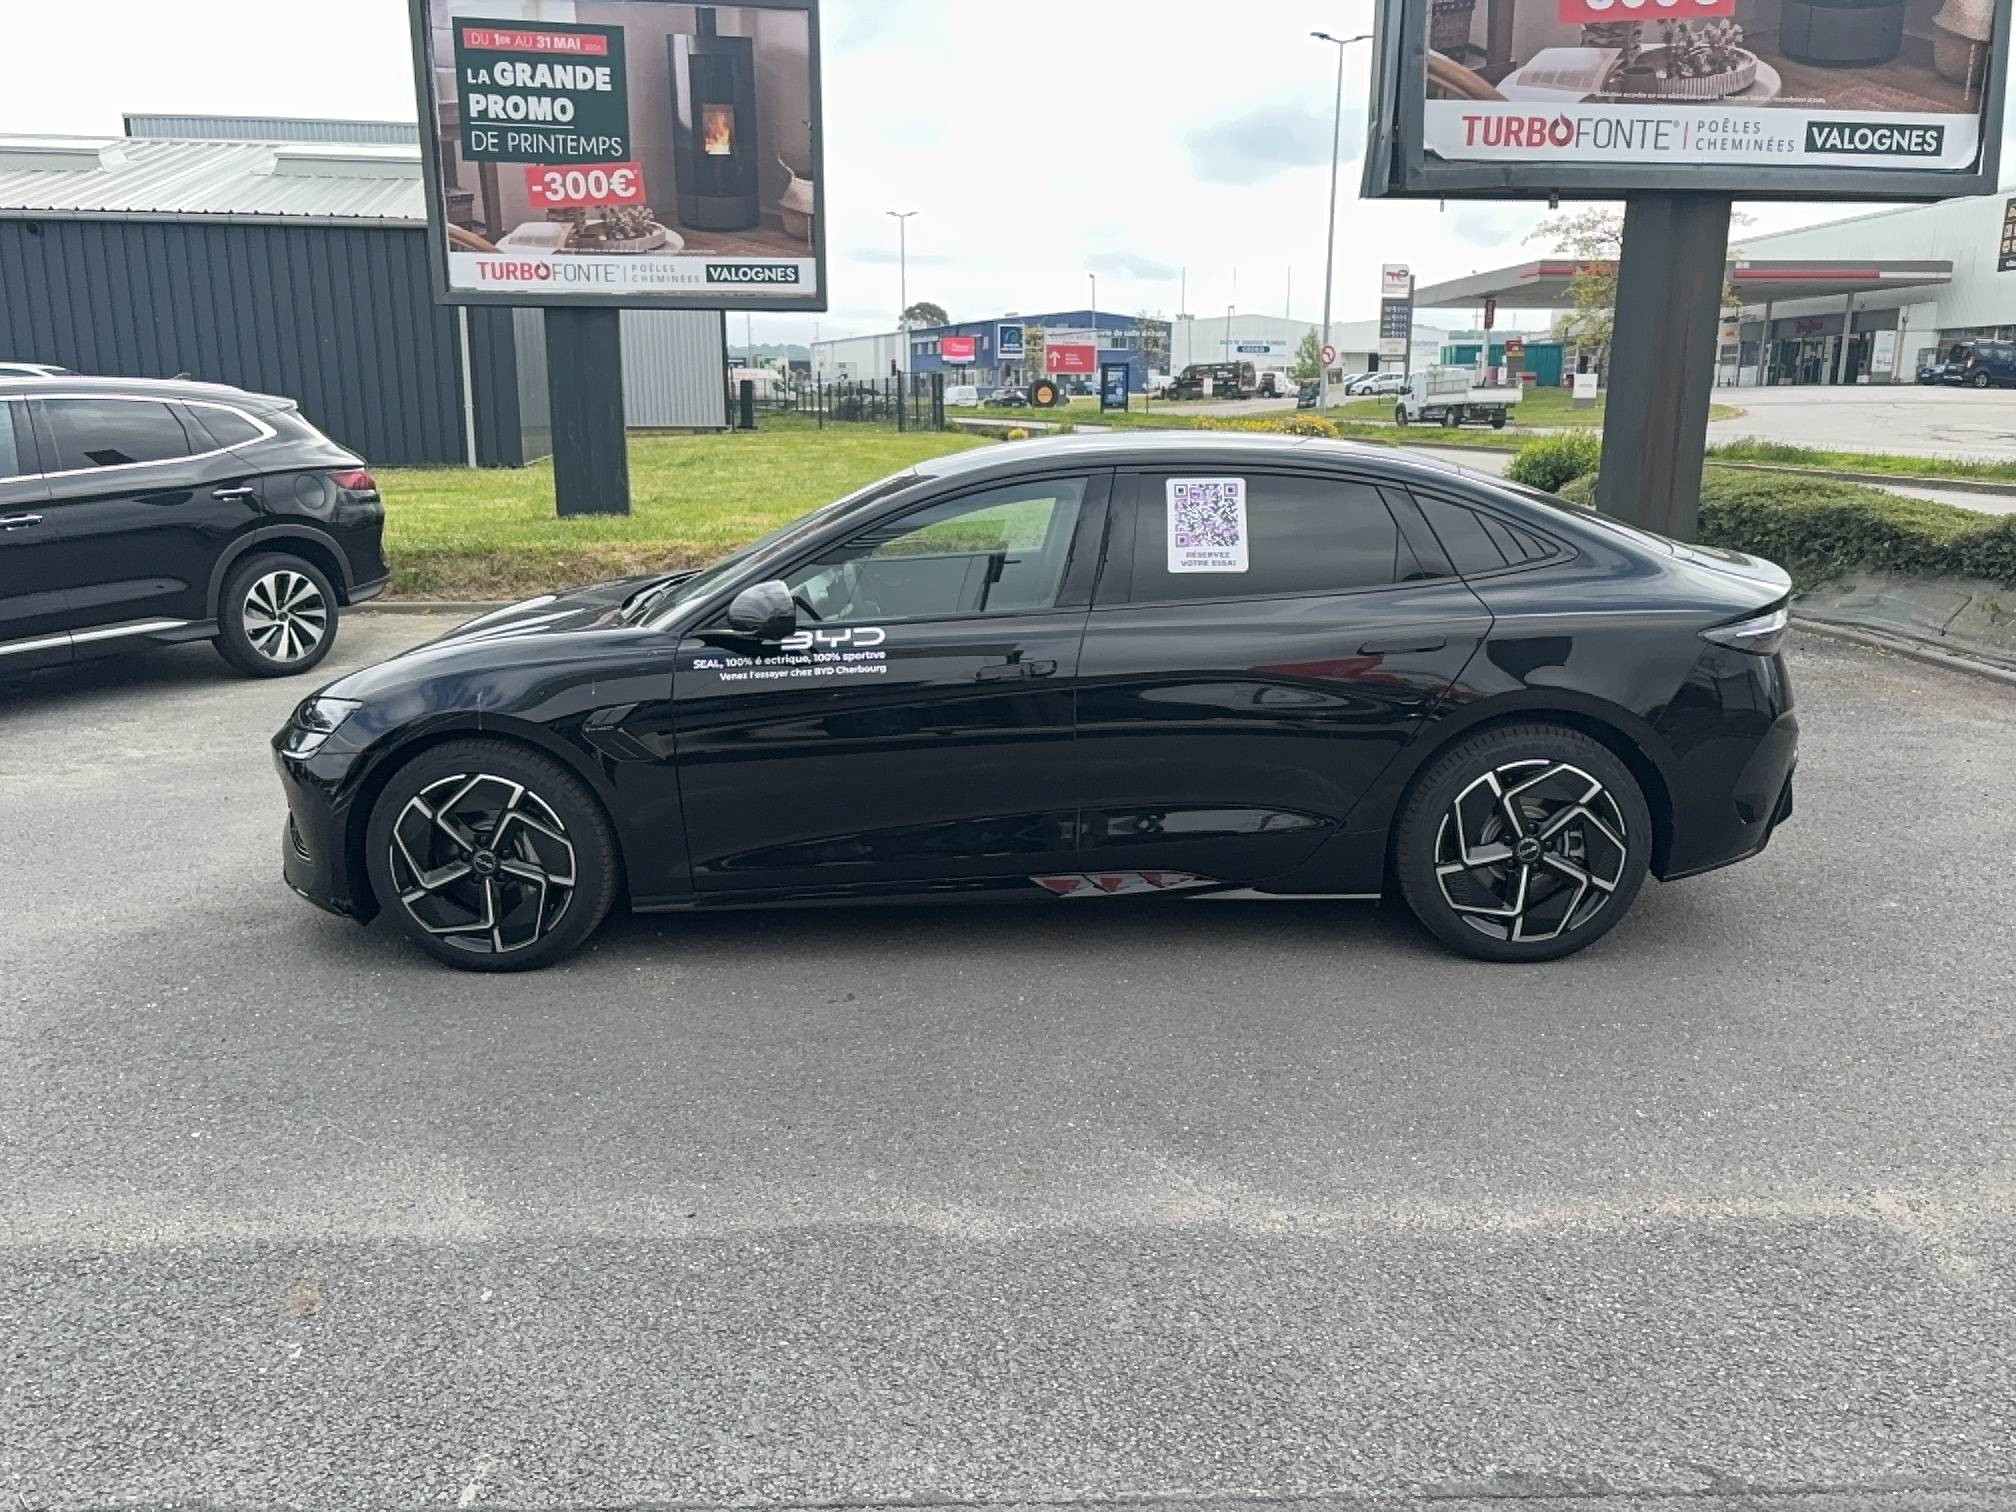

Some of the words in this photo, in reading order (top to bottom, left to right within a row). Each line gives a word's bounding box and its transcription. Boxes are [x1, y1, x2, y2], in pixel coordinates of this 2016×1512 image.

[471, 32, 489, 45] DU
[514, 37, 533, 47] AU
[536, 36, 551, 48] 31
[553, 37, 581, 50] MAI
[466, 68, 491, 85] LA
[493, 61, 612, 91] GRANDE
[468, 93, 575, 122] PROMO
[1697, 118, 1761, 134] POÊLES
[471, 131, 499, 152] DE
[507, 133, 623, 157] PRINTEMPS
[1695, 136, 1795, 153] CHEMINÉES
[1811, 126, 1938, 152] VALOGNES
[631, 274, 700, 284] CHEMINÉES
[709, 267, 797, 282] VALOGNES
[780, 626, 886, 651] BYD
[693, 659, 724, 670] SEAL,
[726, 657, 753, 667] 100%
[813, 651, 841, 663] 100%
[842, 651, 886, 661] sportive
[720, 671, 748, 681] Venez
[790, 667, 812, 677] chez
[813, 666, 834, 676] BYD
[835, 664, 887, 675] Cherbourg
